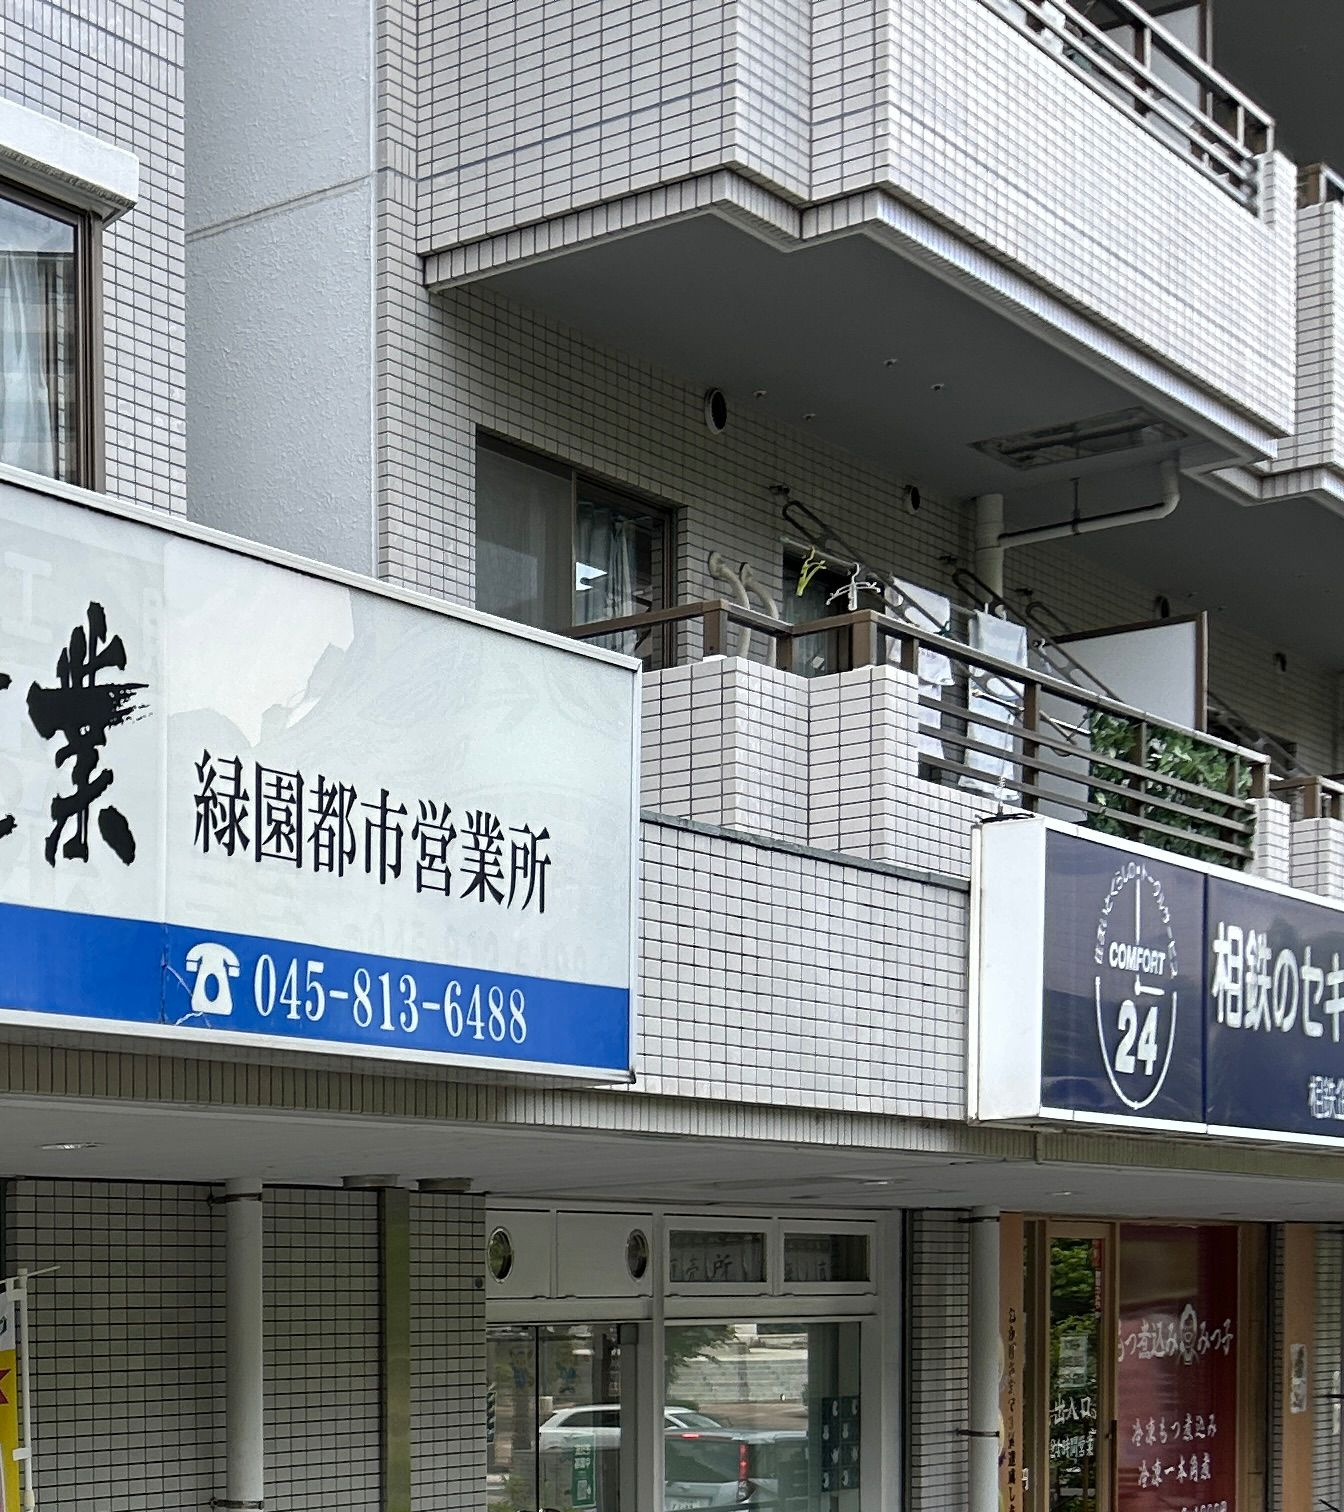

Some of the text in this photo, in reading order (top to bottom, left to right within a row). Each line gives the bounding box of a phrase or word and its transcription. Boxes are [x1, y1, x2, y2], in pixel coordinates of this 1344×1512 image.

[193, 748, 552, 914] 緑園都市営業所
[253, 953, 529, 1045] 045-813-6488
[1108, 940, 1167, 976] COMFORT
[1114, 999, 1159, 1076] 24
